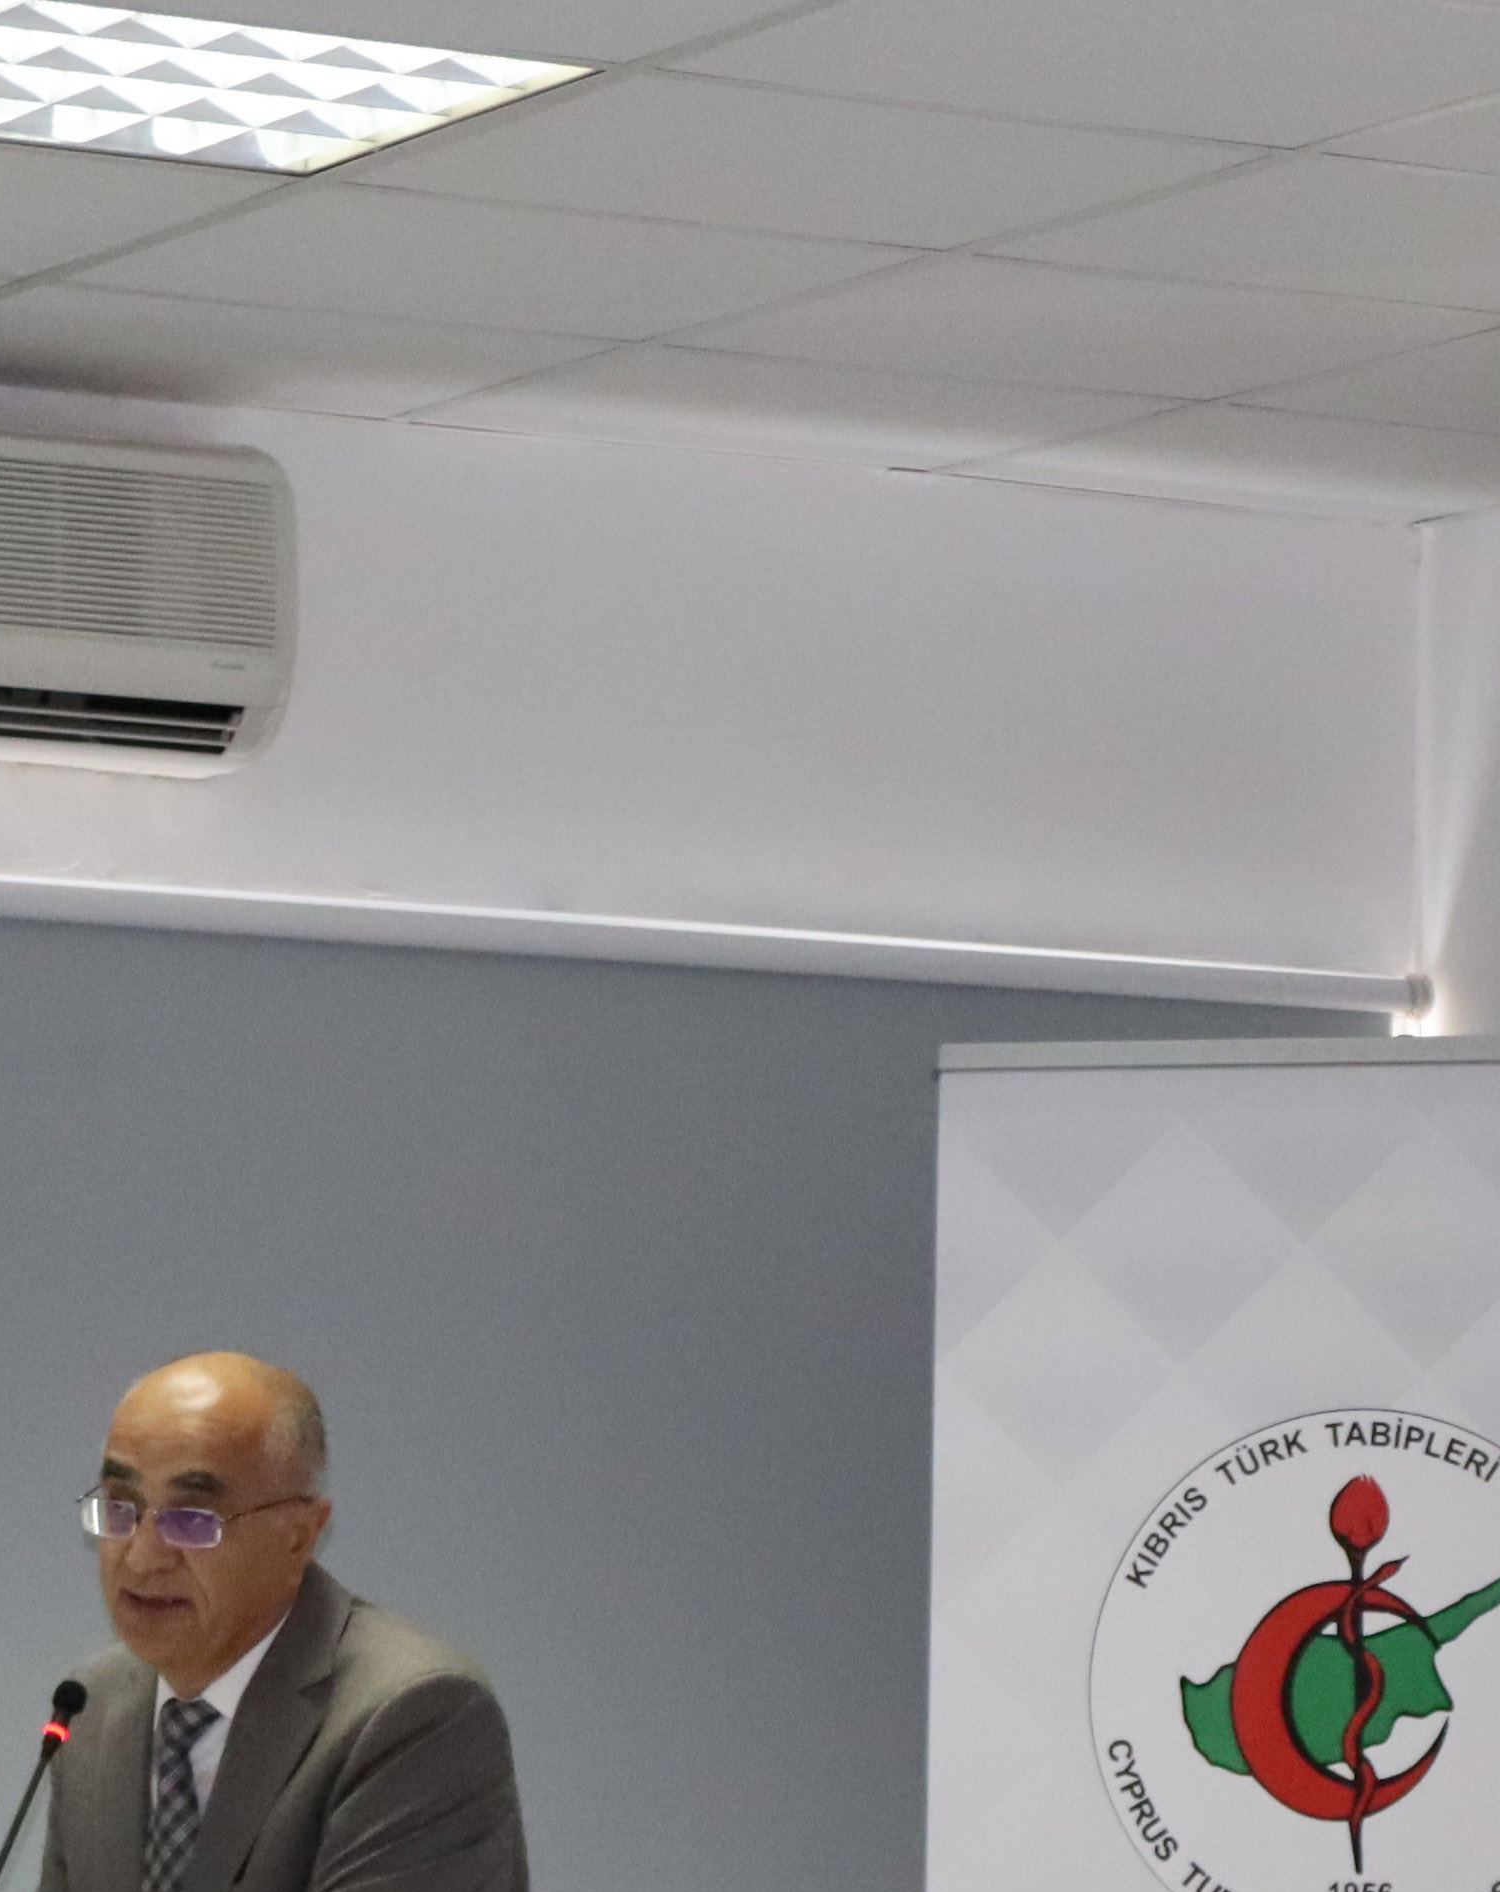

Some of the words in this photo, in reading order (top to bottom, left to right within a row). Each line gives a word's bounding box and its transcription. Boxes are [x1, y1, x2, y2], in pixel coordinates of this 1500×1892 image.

[1124, 1486, 1209, 1588] KIBRIS
[1214, 1429, 1307, 1485] TÜRK
[1108, 1739, 1179, 1862] CYPRUS
